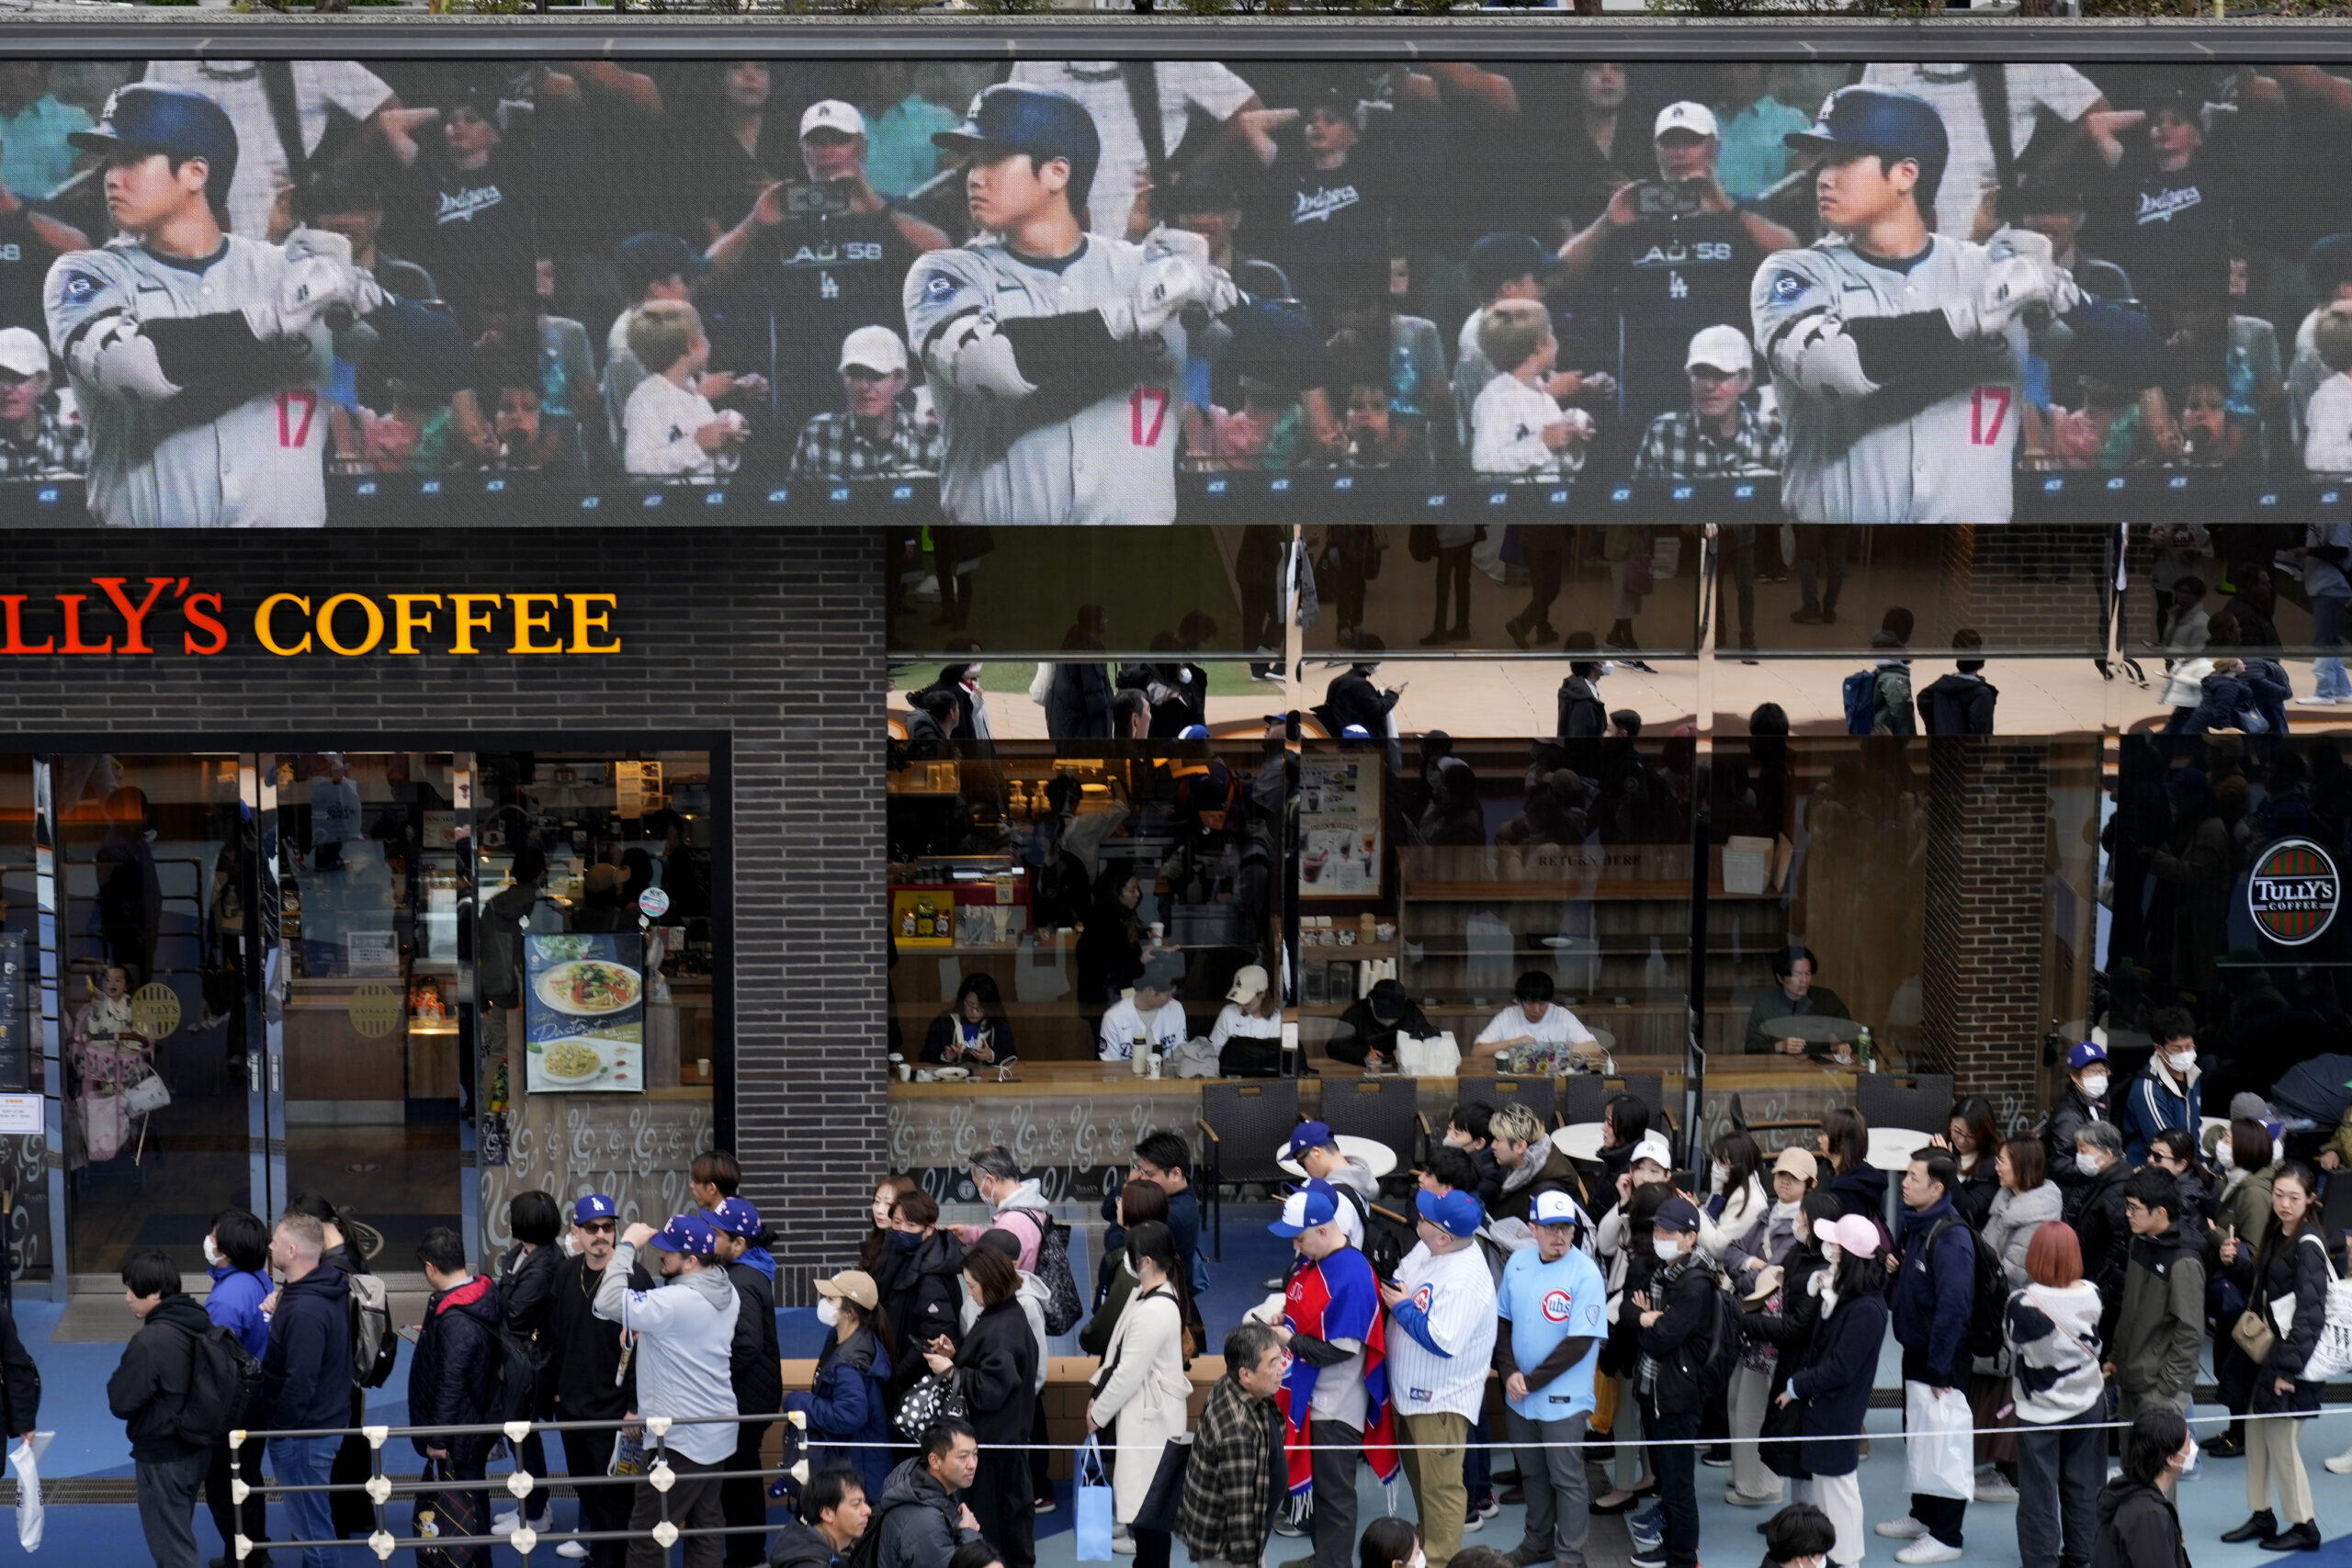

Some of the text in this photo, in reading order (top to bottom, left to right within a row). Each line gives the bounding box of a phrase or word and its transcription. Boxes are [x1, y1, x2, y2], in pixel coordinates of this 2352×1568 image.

[435, 184, 503, 224] Dodgers
[1293, 185, 1360, 224] Dodgers
[2135, 186, 2202, 224] Dodgers
[820, 270, 840, 299] LA
[1669, 270, 1689, 299] LA
[276, 389, 317, 448] 17
[1129, 387, 1169, 447] 17
[1971, 386, 2010, 446] 17
[254, 592, 622, 656] COFFEE
[1538, 855, 1597, 867] RETURN
[2256, 880, 2333, 901] TULLY'S
[2268, 900, 2320, 911] COFFEE
[592, 1197, 605, 1211] LA
[1555, 1201, 1565, 1211] C
